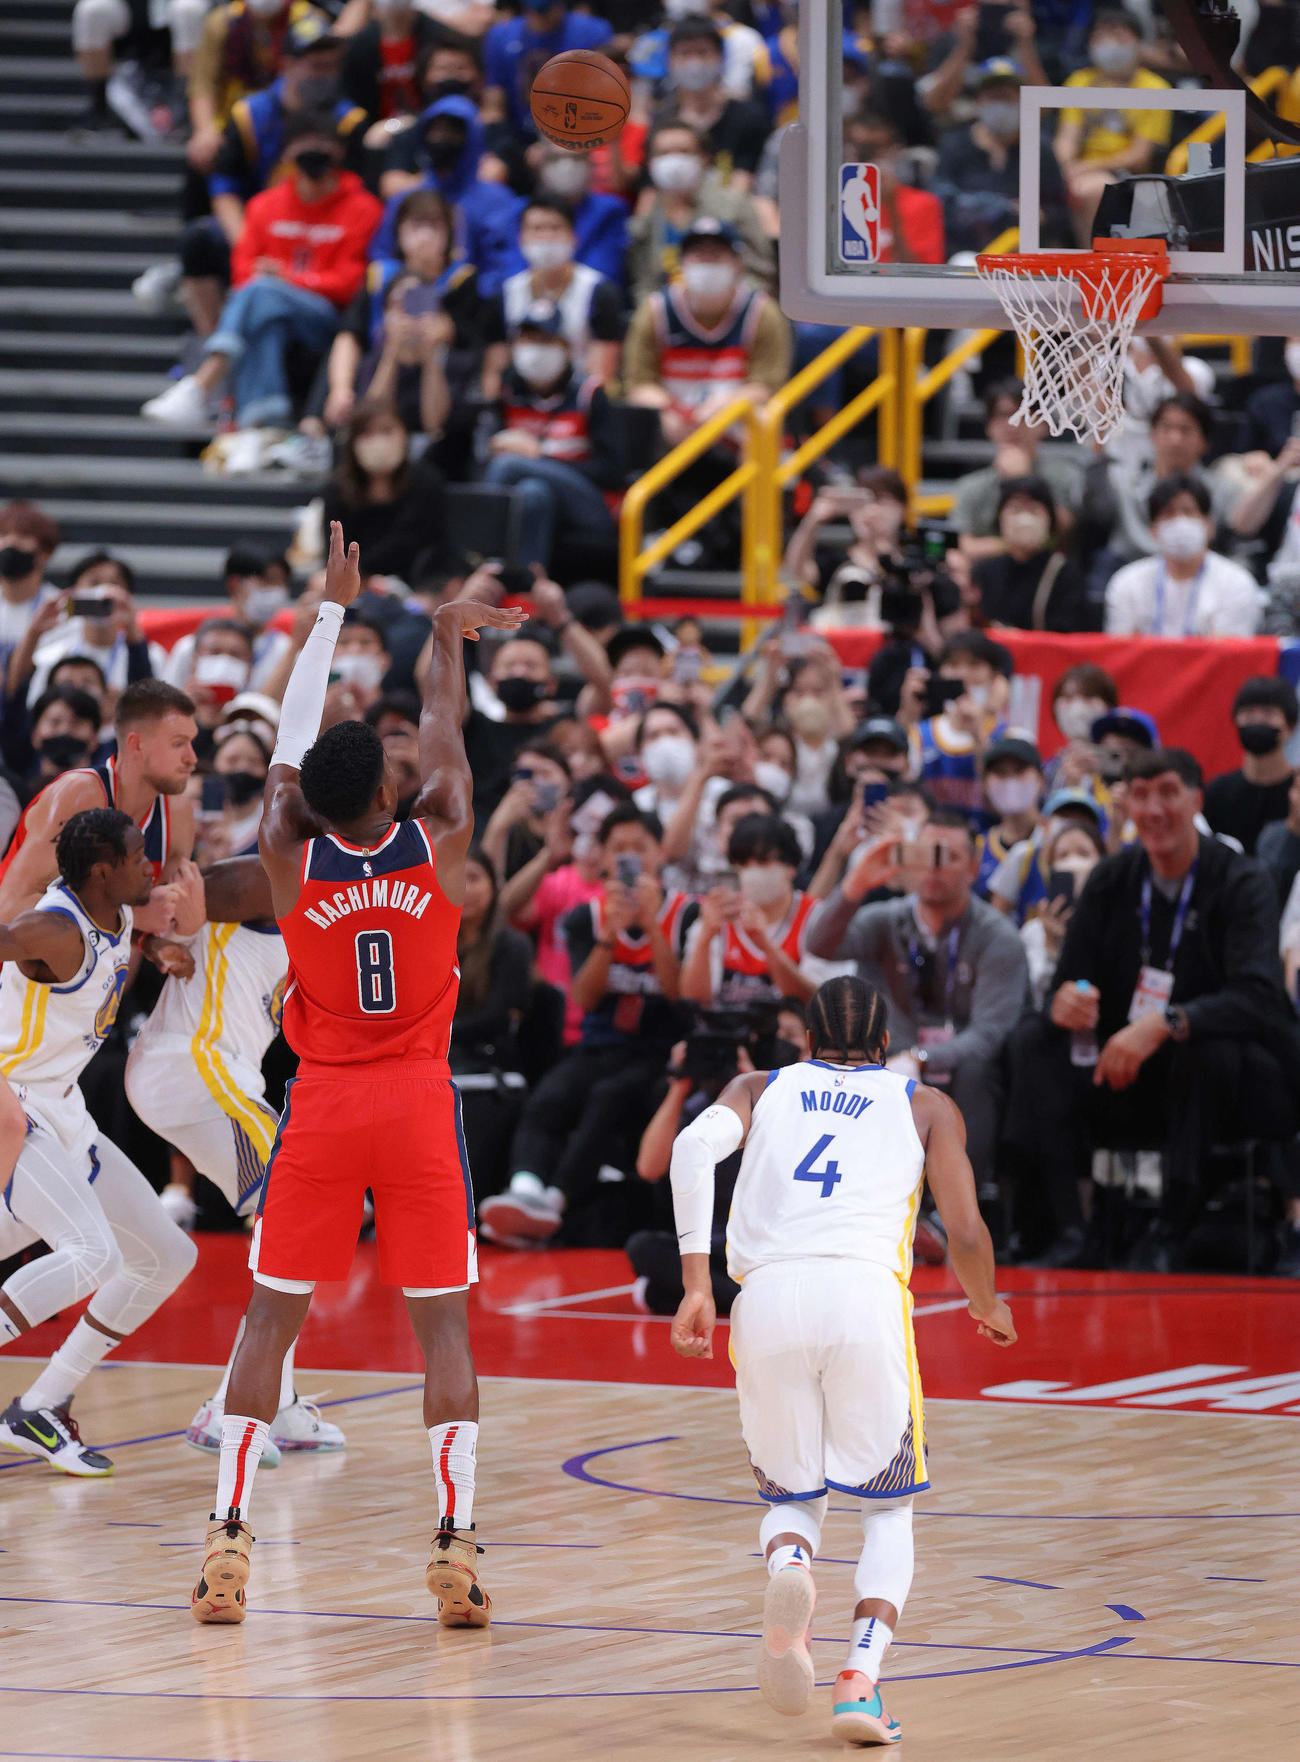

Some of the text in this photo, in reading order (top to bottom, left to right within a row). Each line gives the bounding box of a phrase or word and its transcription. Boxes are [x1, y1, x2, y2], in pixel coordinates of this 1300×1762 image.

[303, 879, 433, 930] HACHIMURA
[354, 929, 397, 1014] 8
[800, 1090, 874, 1119] MOODY
[793, 1133, 842, 1198] 4
[980, 1363, 1300, 1412] JA
